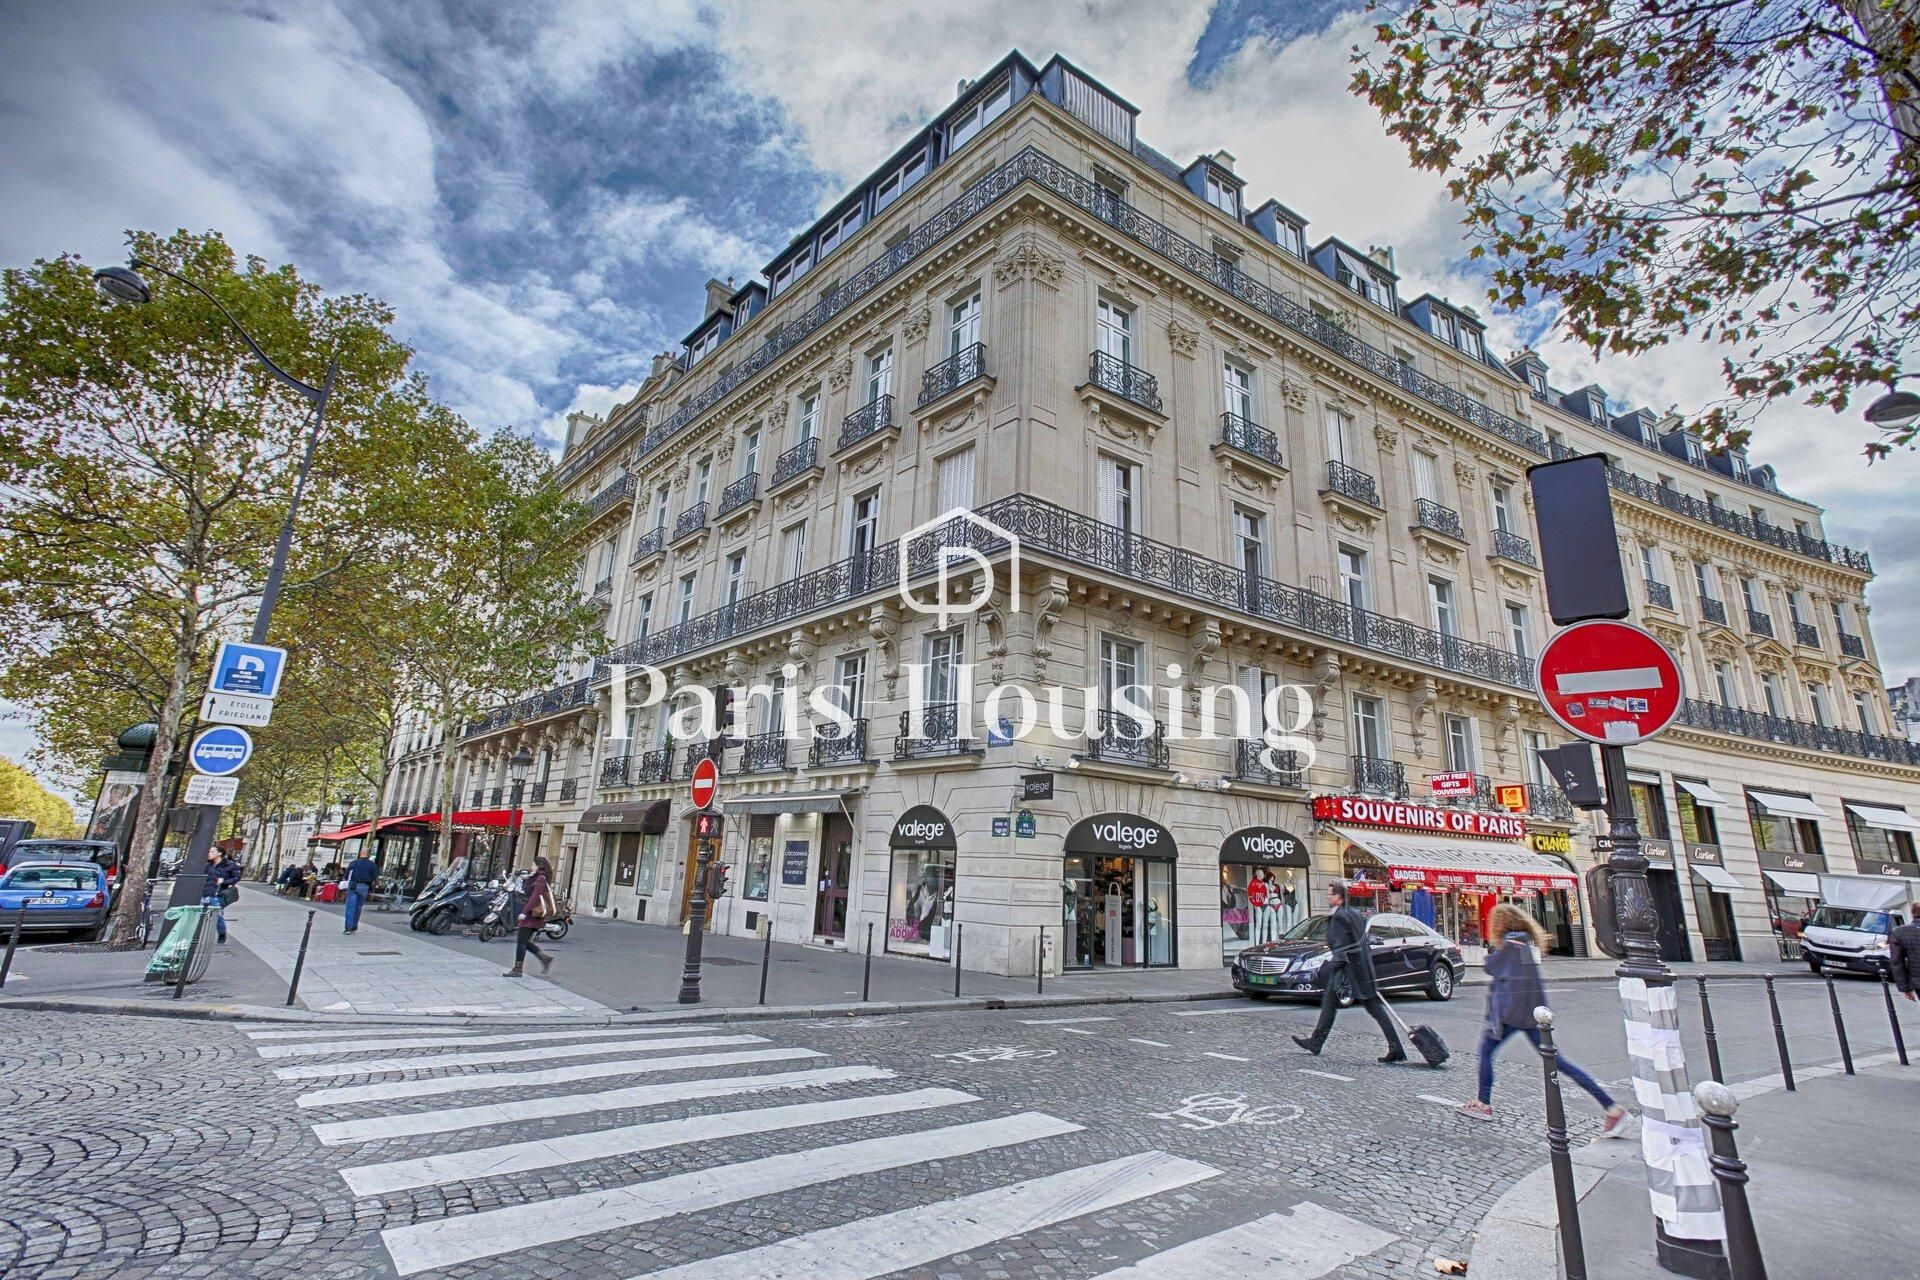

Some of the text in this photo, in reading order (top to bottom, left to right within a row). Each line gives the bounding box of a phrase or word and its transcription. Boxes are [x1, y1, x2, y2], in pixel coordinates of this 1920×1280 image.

[218, 710, 267, 721] FRIEDLAND
[1432, 774, 1450, 782] DUTY
[1025, 782, 1050, 793] valege
[1433, 788, 1471, 796] SOUVENIRS
[1341, 800, 1523, 836] SOUVENIRS OF PARIS
[898, 820, 944, 840] valege
[1092, 820, 1158, 849] valege
[1241, 833, 1294, 858] valege
[1536, 836, 1570, 853] CHANGE
[1644, 843, 1667, 857] Cartier
[1694, 847, 1715, 860] Cartier
[1784, 856, 1804, 868] Cartier
[1393, 870, 1425, 880] GADGETS
[1881, 864, 1901, 876] Cartier
